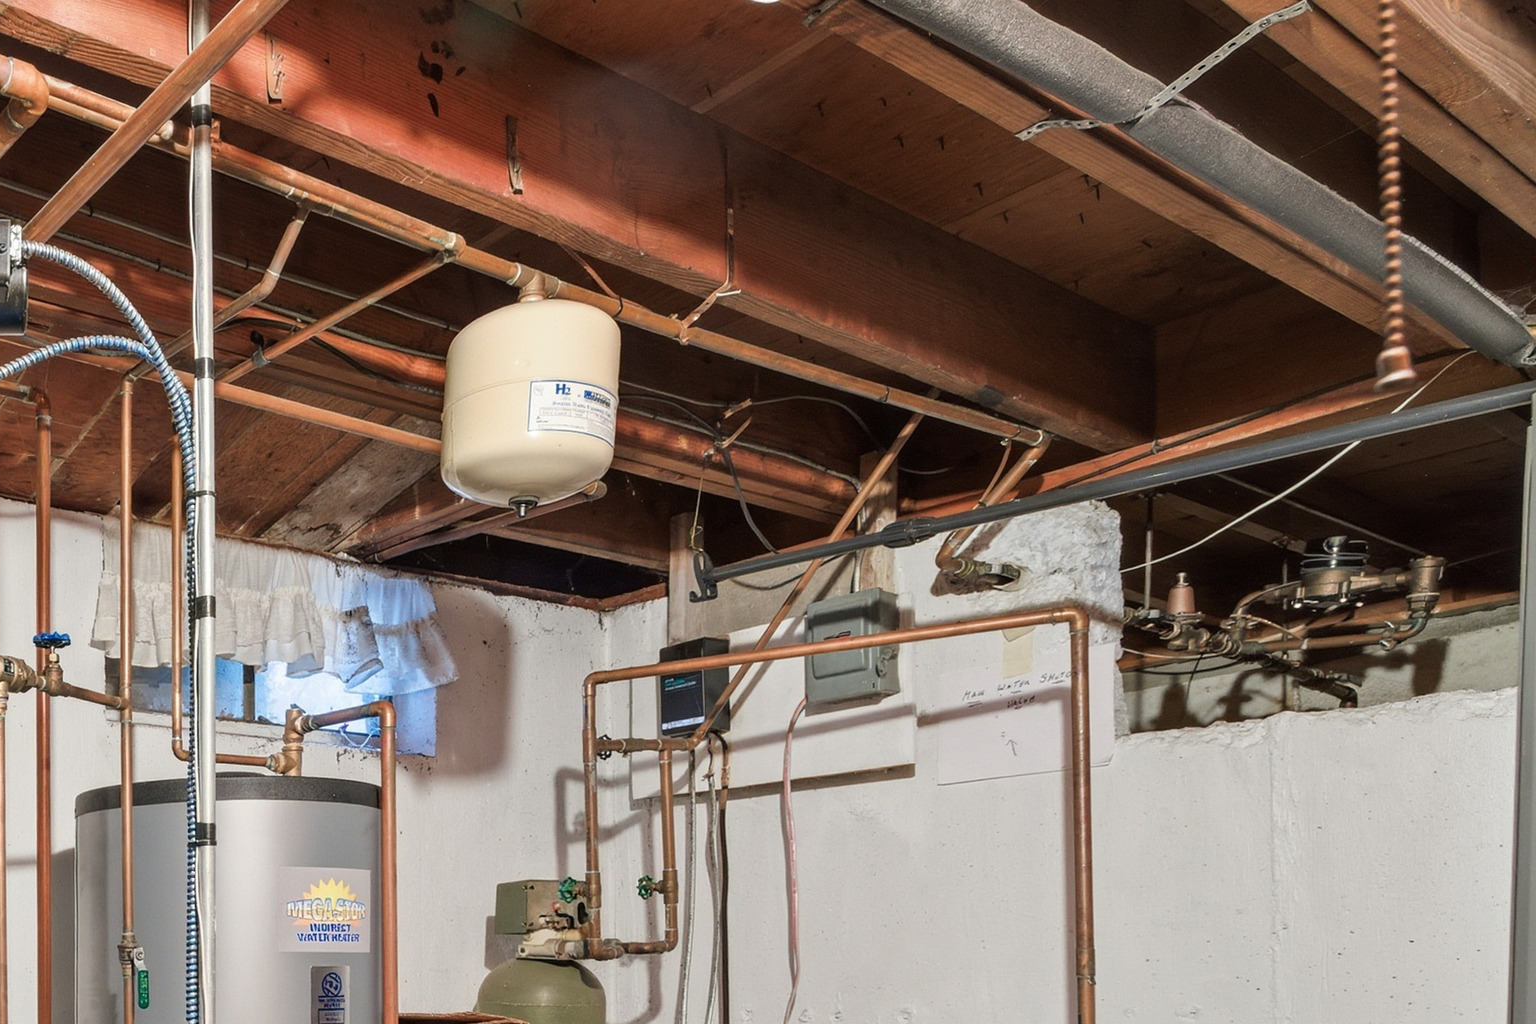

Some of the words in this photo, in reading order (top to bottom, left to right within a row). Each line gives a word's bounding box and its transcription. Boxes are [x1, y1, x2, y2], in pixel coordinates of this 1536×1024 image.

[309, 923, 351, 932] INDIRECT
[297, 933, 329, 942] WATER
[331, 933, 360, 942] HEATER
